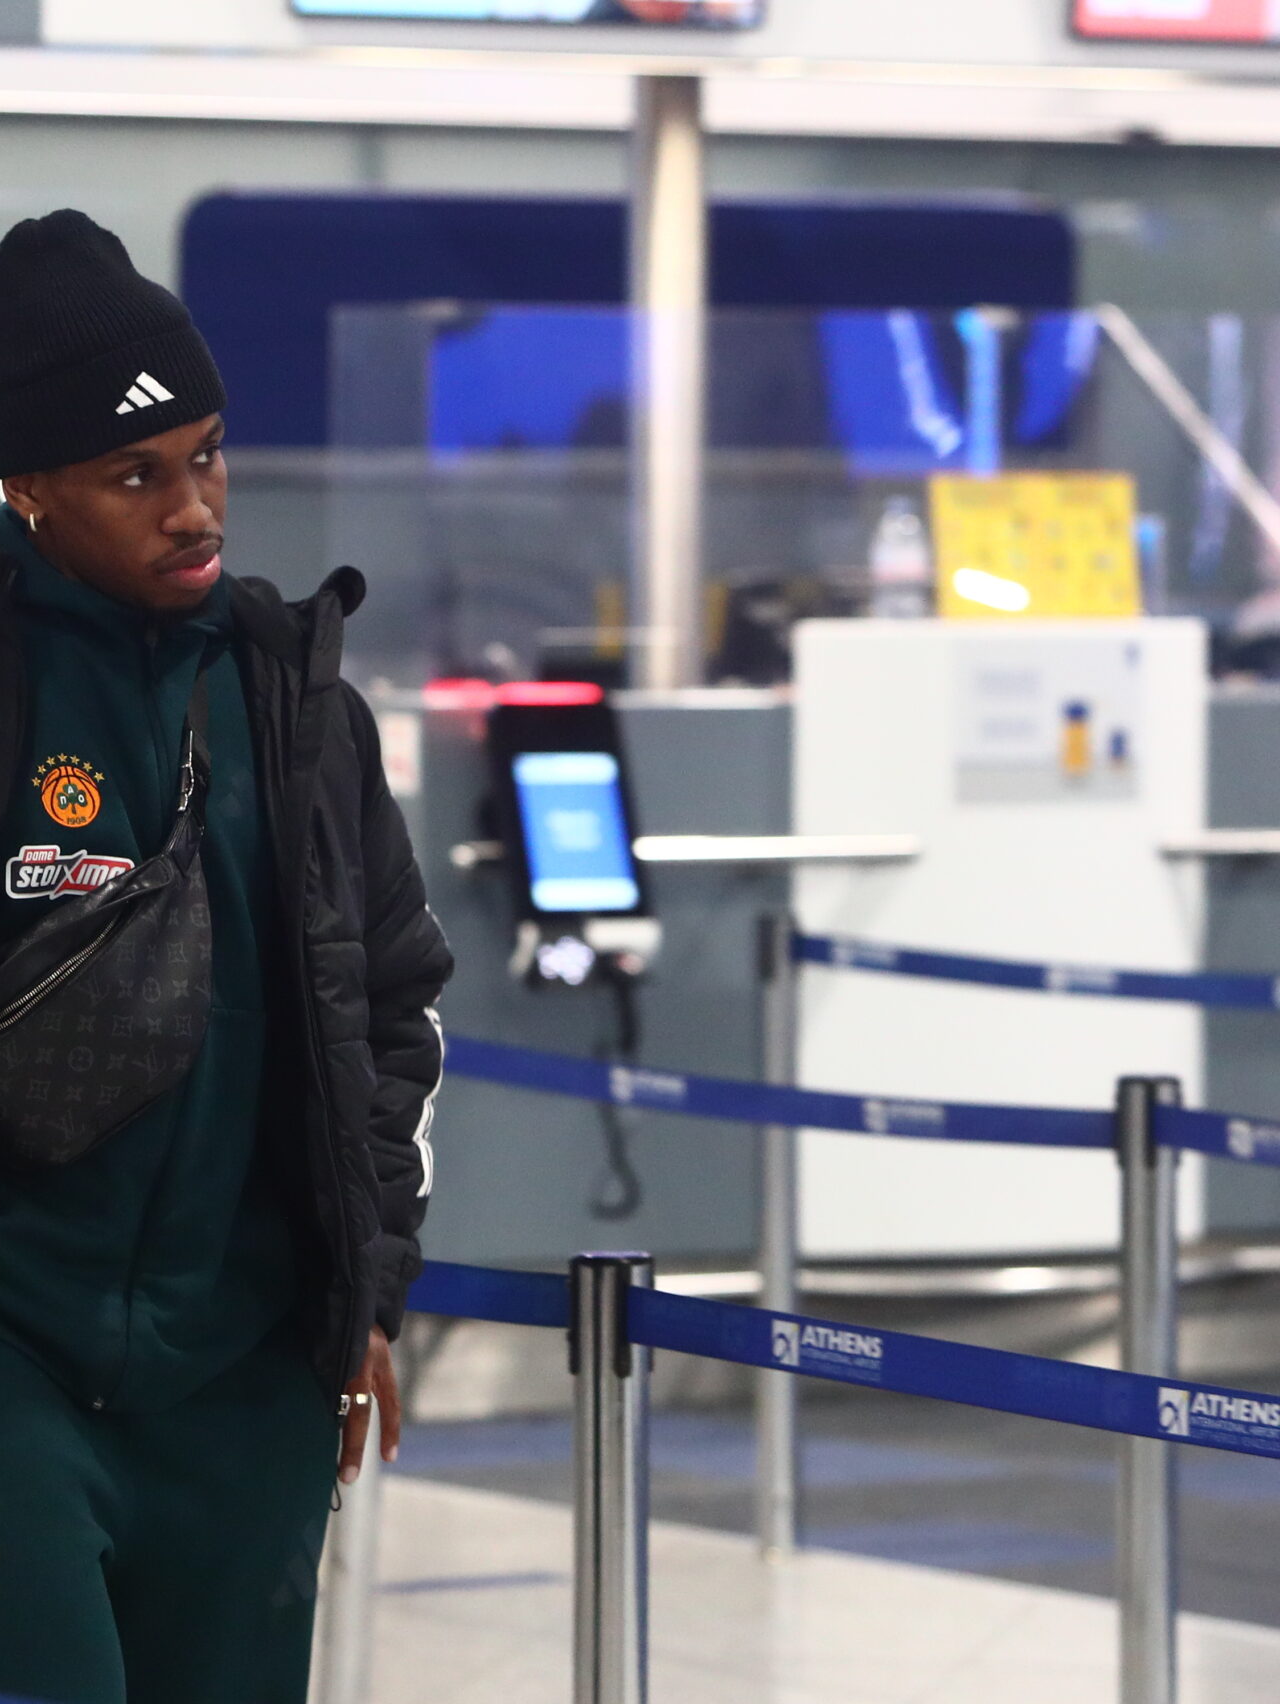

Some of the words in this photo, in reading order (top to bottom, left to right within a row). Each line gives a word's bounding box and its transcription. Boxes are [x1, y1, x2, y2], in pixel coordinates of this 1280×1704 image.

[25, 850, 54, 863] pame
[801, 1324, 883, 1359] ATHENS
[1191, 1391, 1280, 1427] ATHENS
